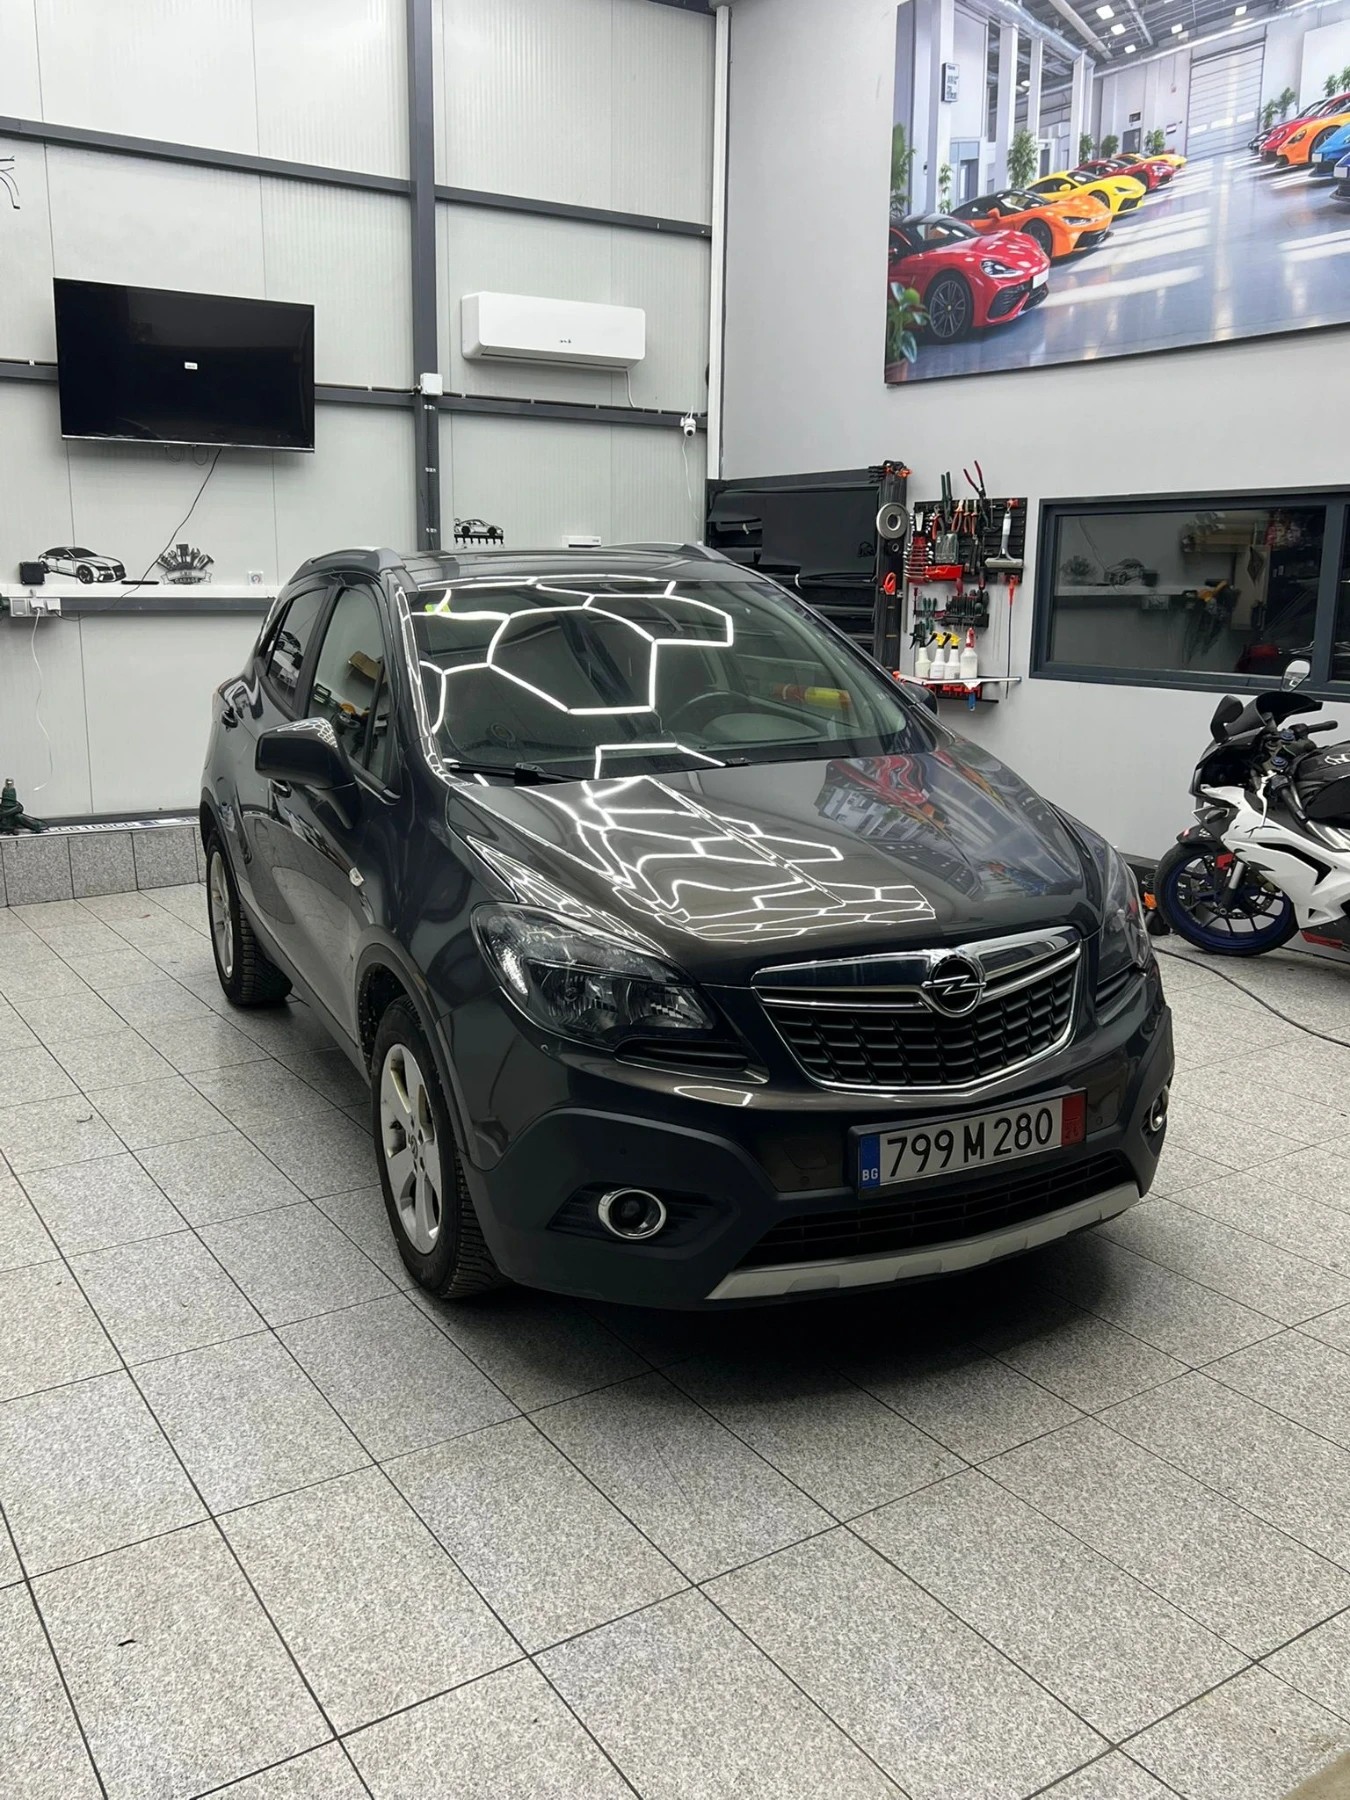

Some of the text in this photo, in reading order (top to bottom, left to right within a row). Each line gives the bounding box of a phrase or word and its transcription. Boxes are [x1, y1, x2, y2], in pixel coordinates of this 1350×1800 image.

[862, 1108, 1053, 1181] BG 799 M 280
